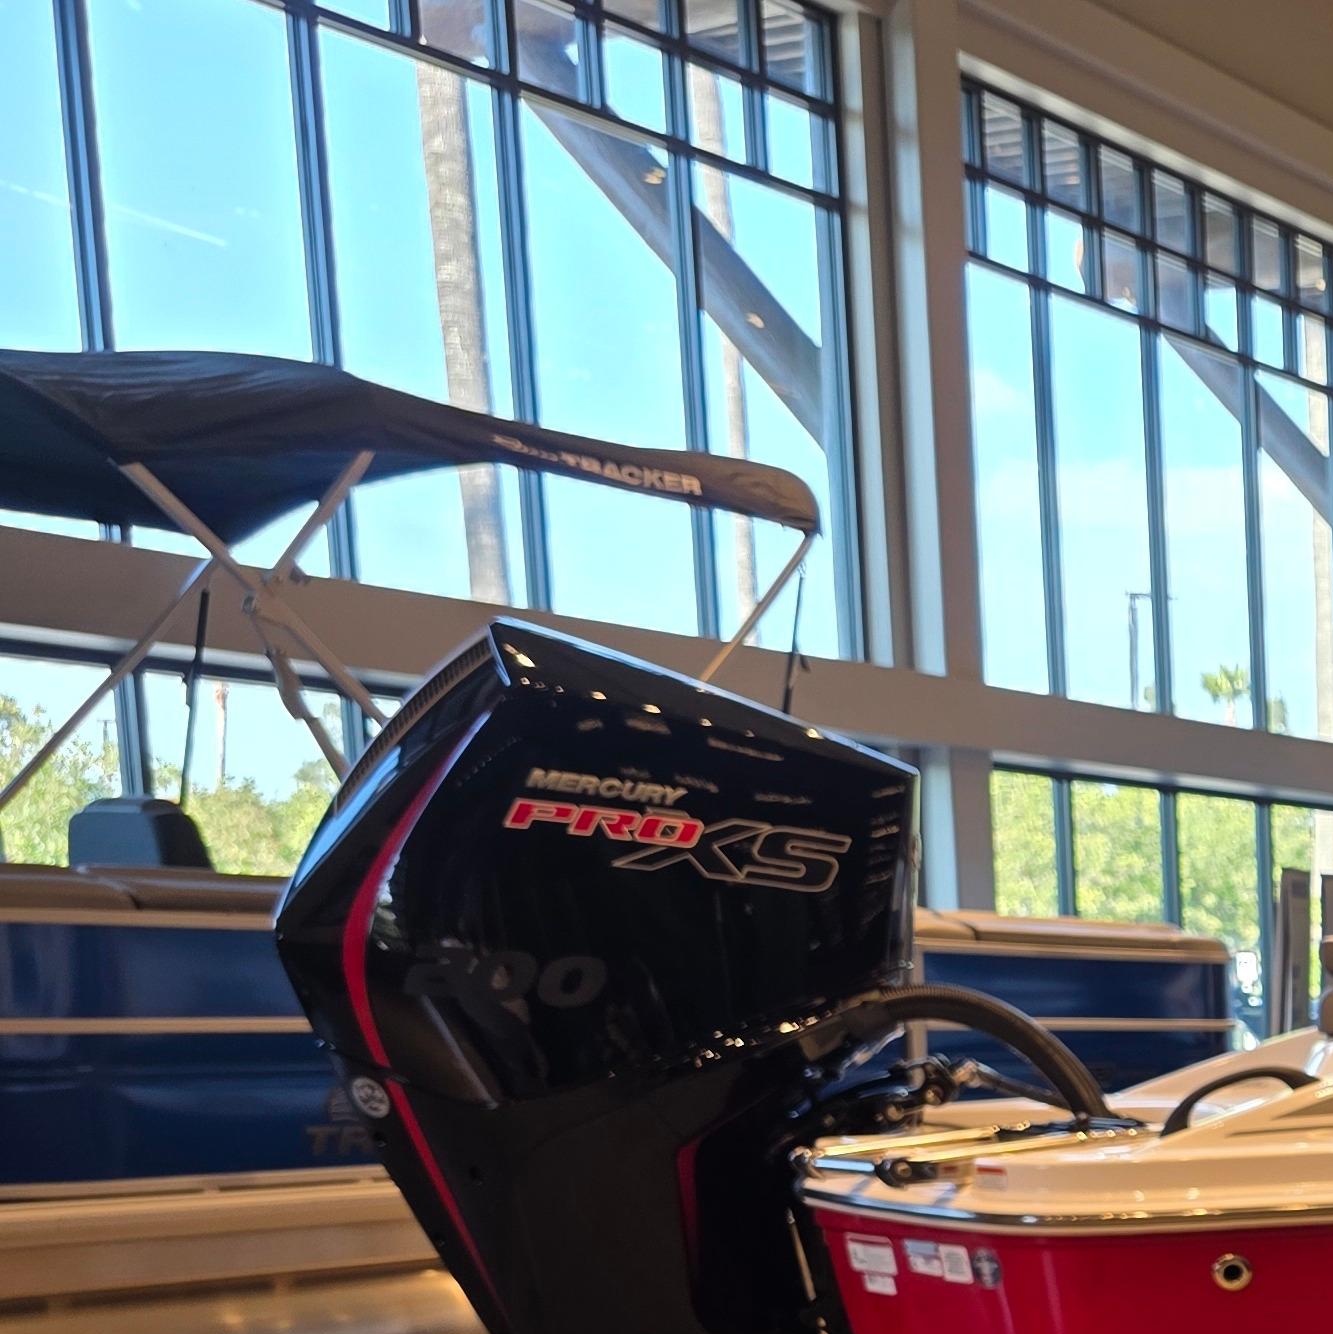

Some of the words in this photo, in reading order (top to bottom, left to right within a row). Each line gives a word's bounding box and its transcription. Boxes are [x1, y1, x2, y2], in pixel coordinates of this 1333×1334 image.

[560, 452, 704, 497] TRACKER
[526, 767, 689, 806] MERCURY
[503, 797, 704, 849] PRO
[611, 818, 853, 893] XS
